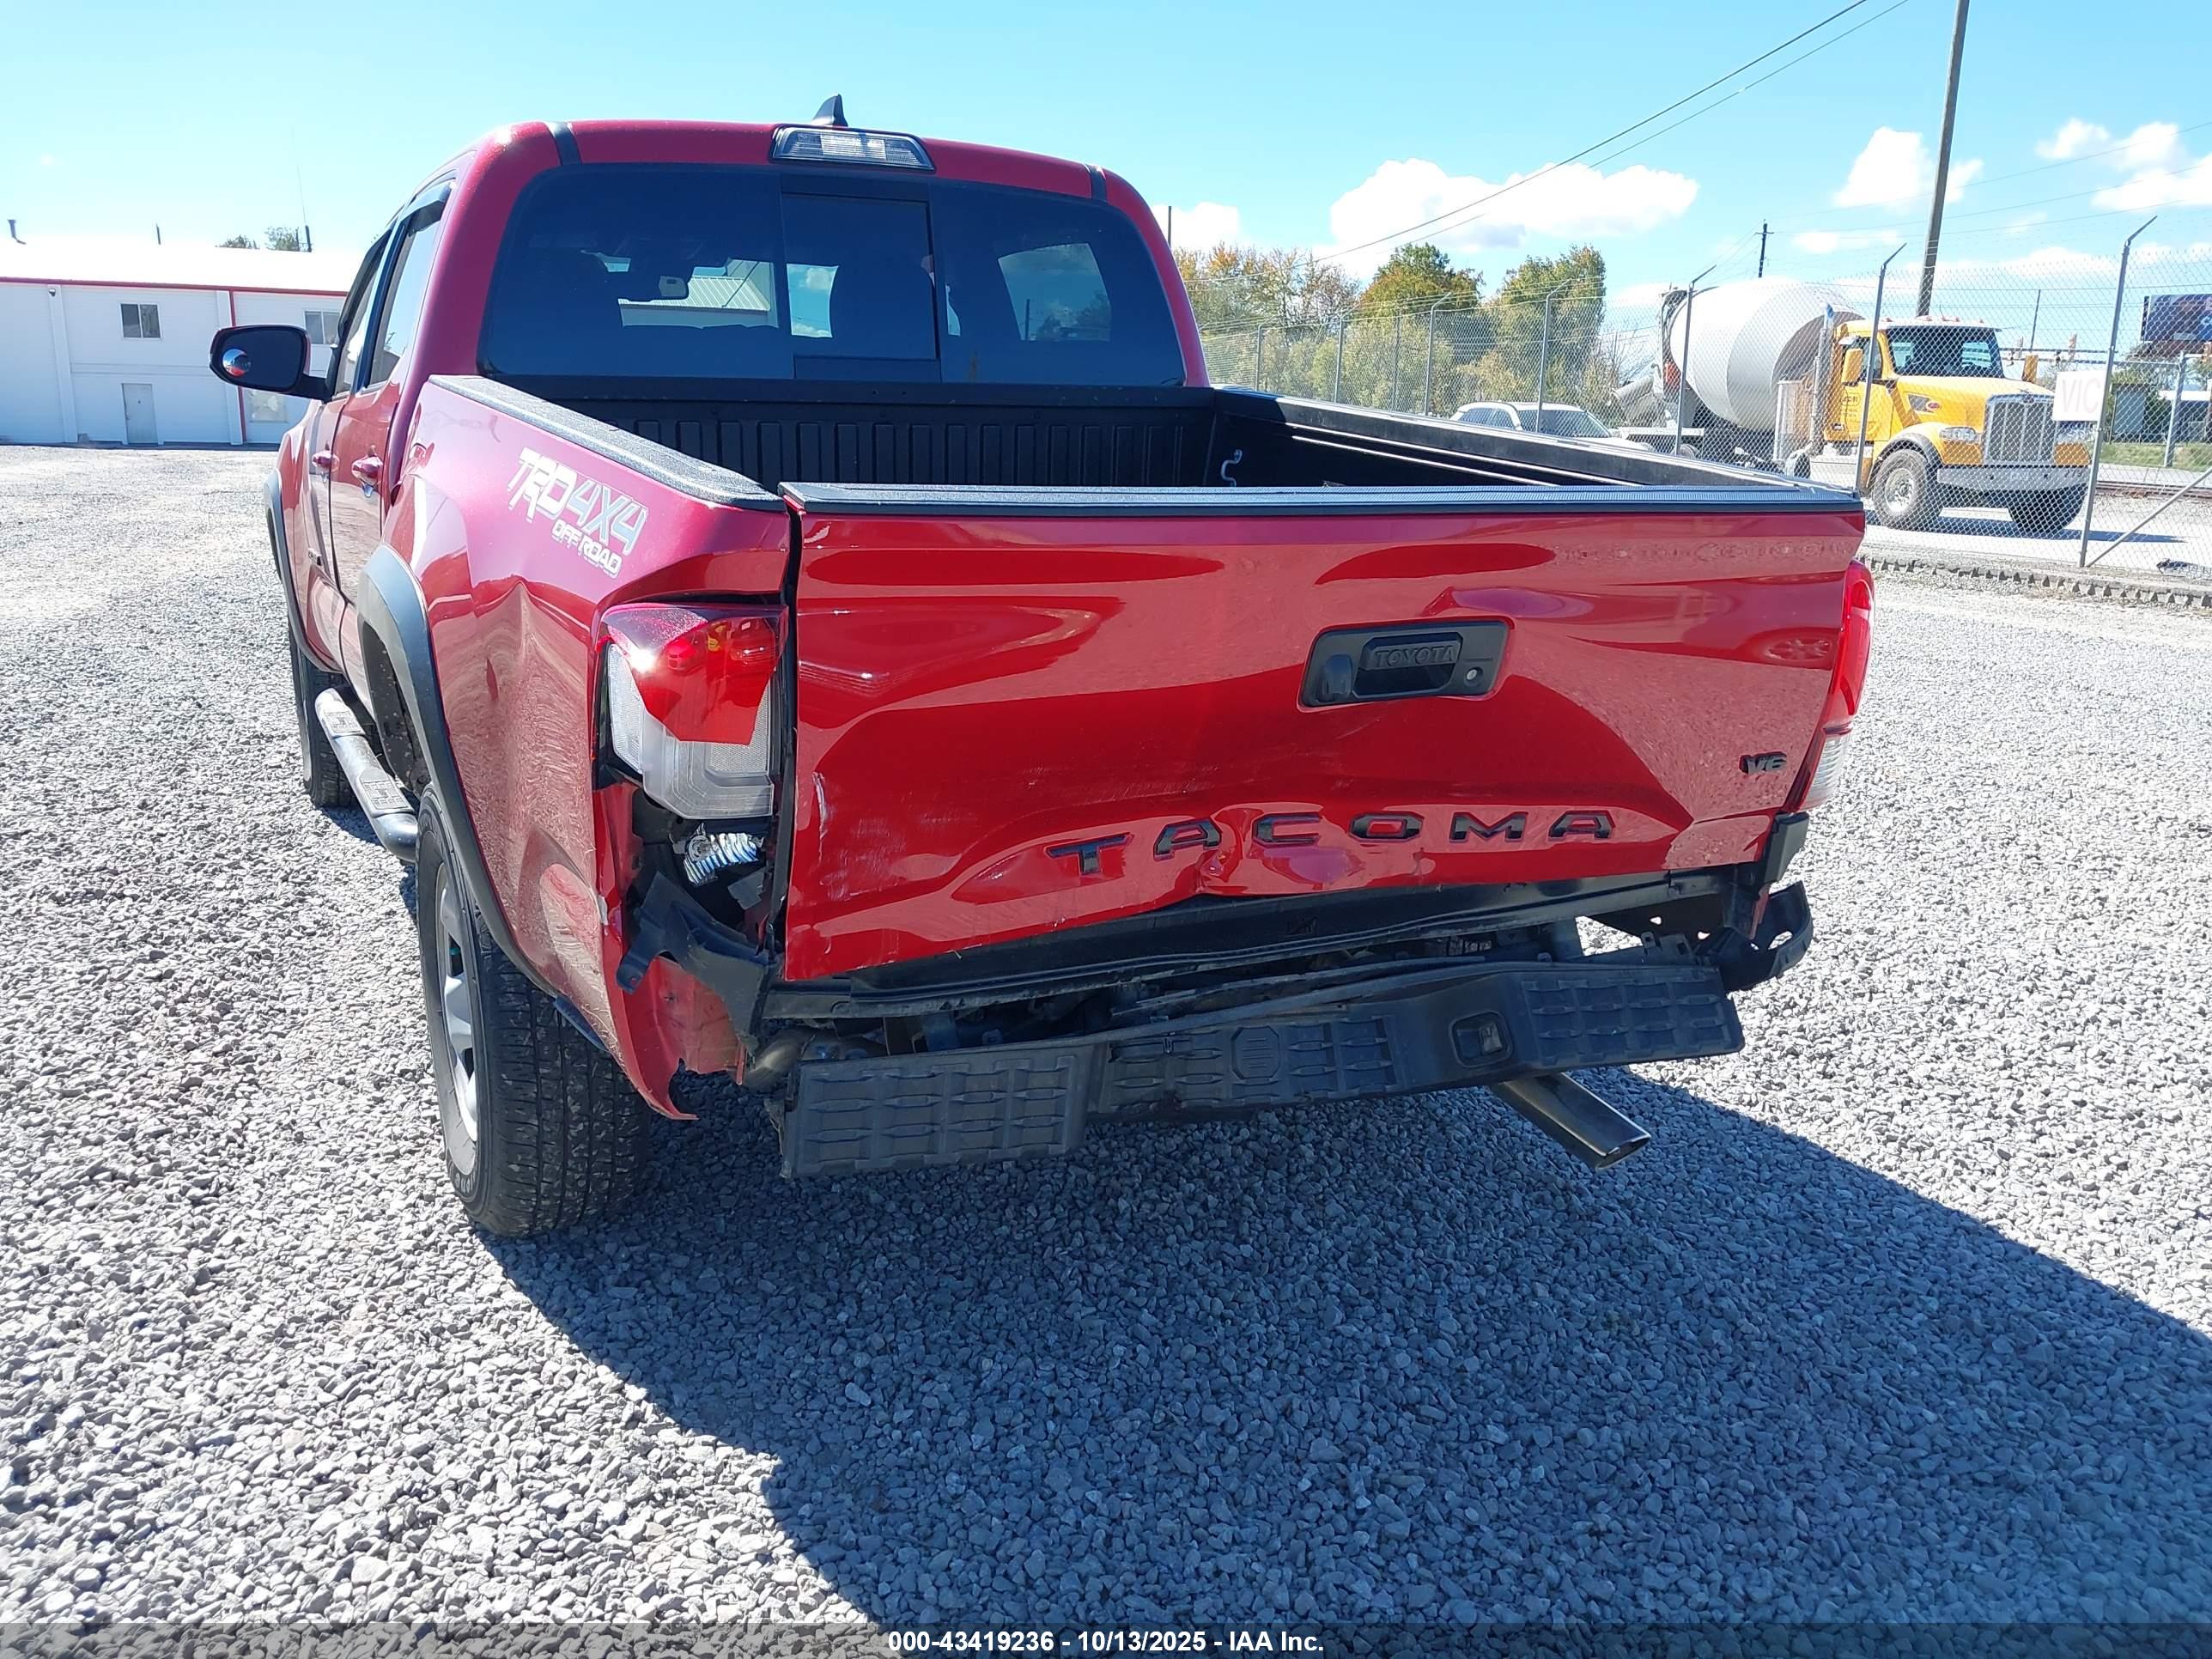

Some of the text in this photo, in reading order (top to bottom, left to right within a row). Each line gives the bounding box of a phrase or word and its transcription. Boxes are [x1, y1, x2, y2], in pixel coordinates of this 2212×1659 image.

[507, 447, 578, 524] TRD
[551, 518, 623, 579] OFF ROAD
[1375, 646, 1455, 668] TOYOTA
[1739, 751, 1787, 775] V6
[1044, 809, 1615, 875] TACOMA
